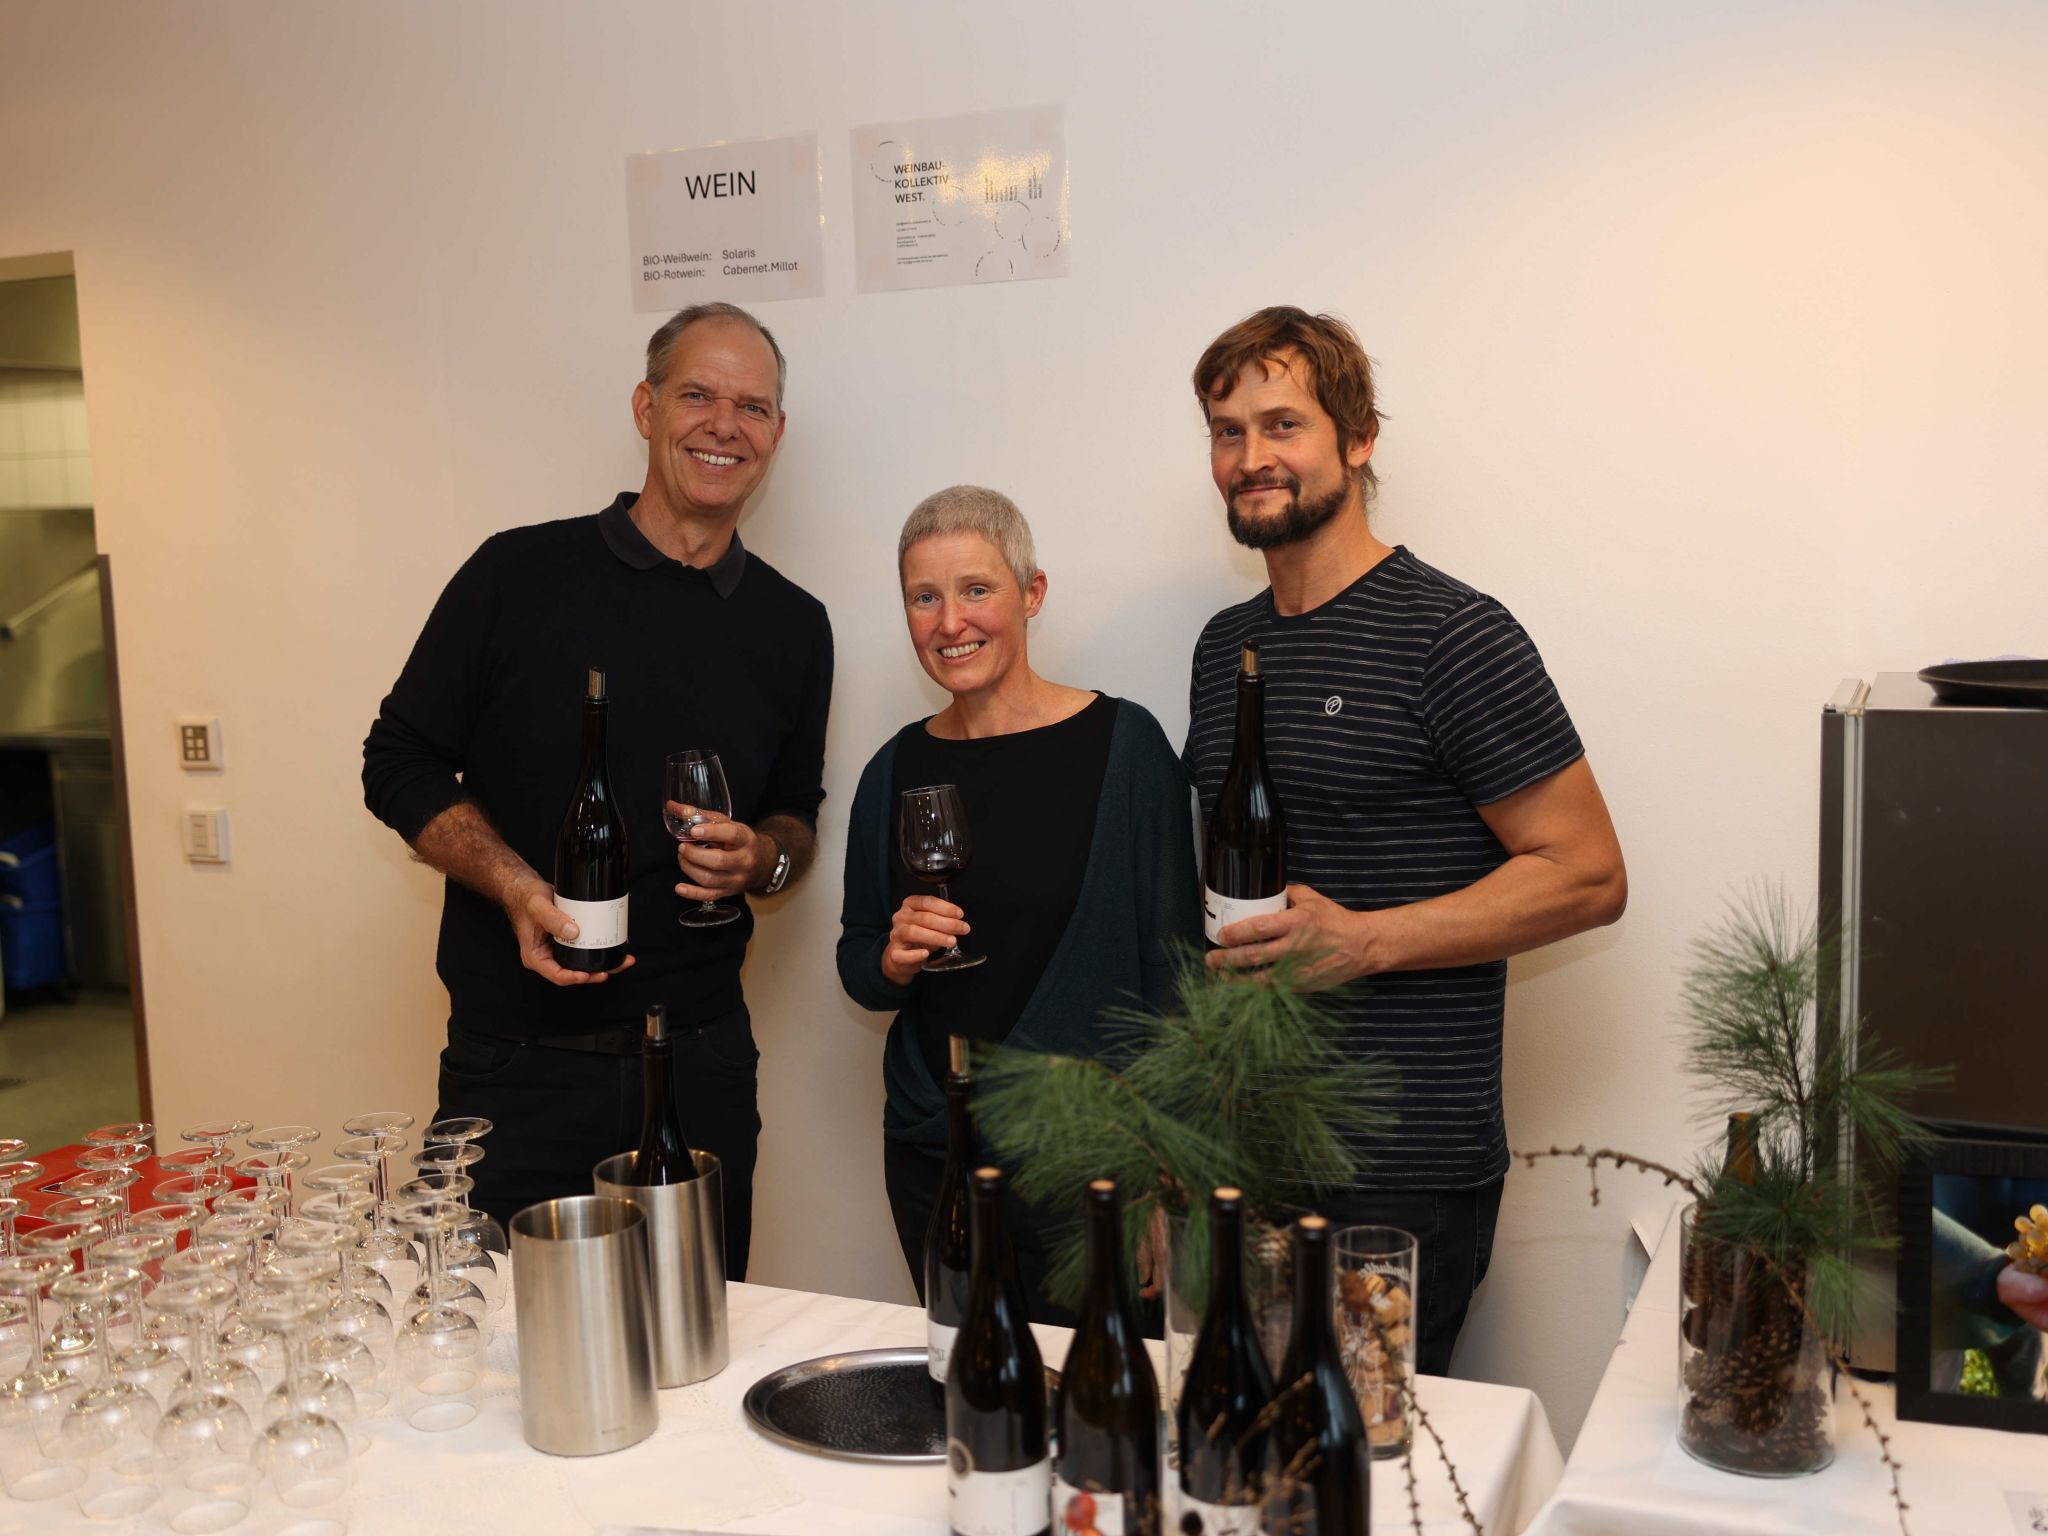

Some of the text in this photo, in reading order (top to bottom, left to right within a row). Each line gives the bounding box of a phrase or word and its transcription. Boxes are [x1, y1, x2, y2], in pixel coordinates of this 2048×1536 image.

[894, 161, 945, 175] WEINBAU-
[685, 170, 756, 200] WEIN
[894, 175, 949, 189] KOLLEKTIV
[895, 192, 926, 204] WEST.
[643, 249, 756, 266] BIO-Weißwein: Solaris
[643, 268, 705, 281] BIO-Rotwein:
